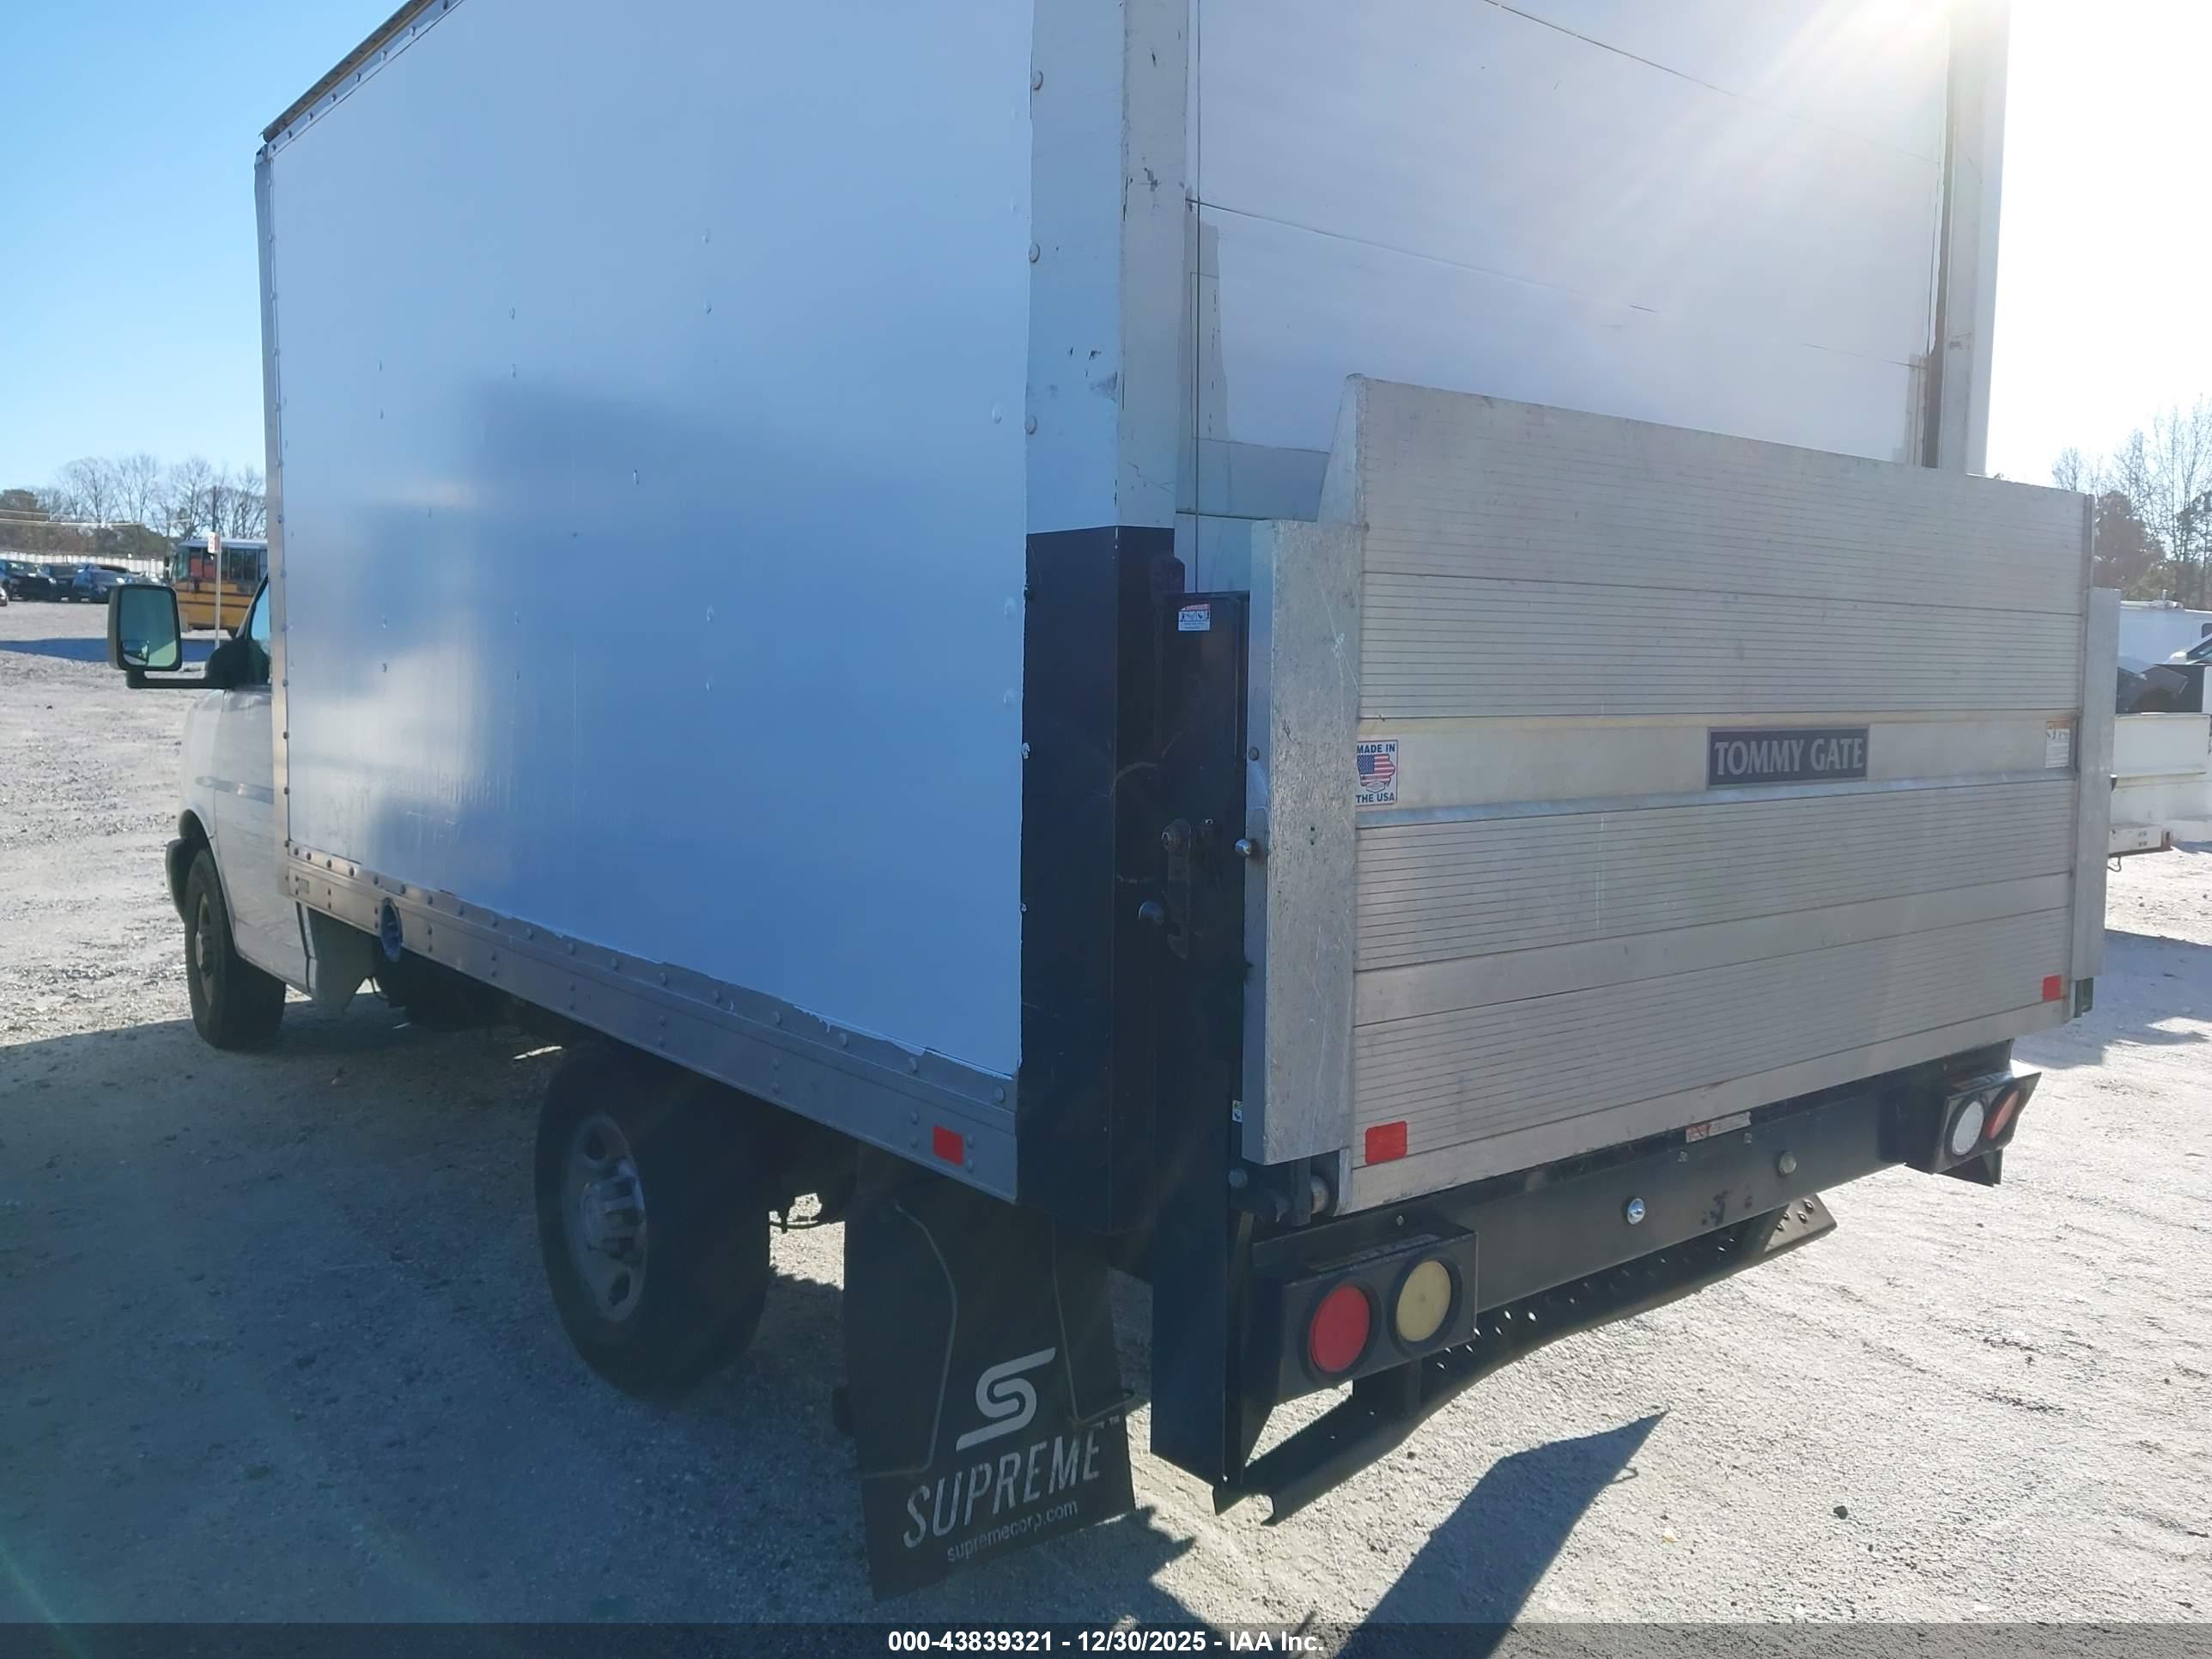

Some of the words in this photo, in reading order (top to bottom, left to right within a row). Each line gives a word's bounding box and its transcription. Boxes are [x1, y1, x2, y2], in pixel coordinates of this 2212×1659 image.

[1357, 744, 1382, 753] MADE
[1386, 744, 1395, 752] IN
[1714, 739, 1804, 775] TOMMY
[1809, 738, 1863, 771] GATE
[1356, 794, 1374, 804] THE
[1376, 793, 1395, 802] USA
[903, 1422, 1104, 1548] SUPREME
[947, 1501, 1079, 1562] supremecorp.com
